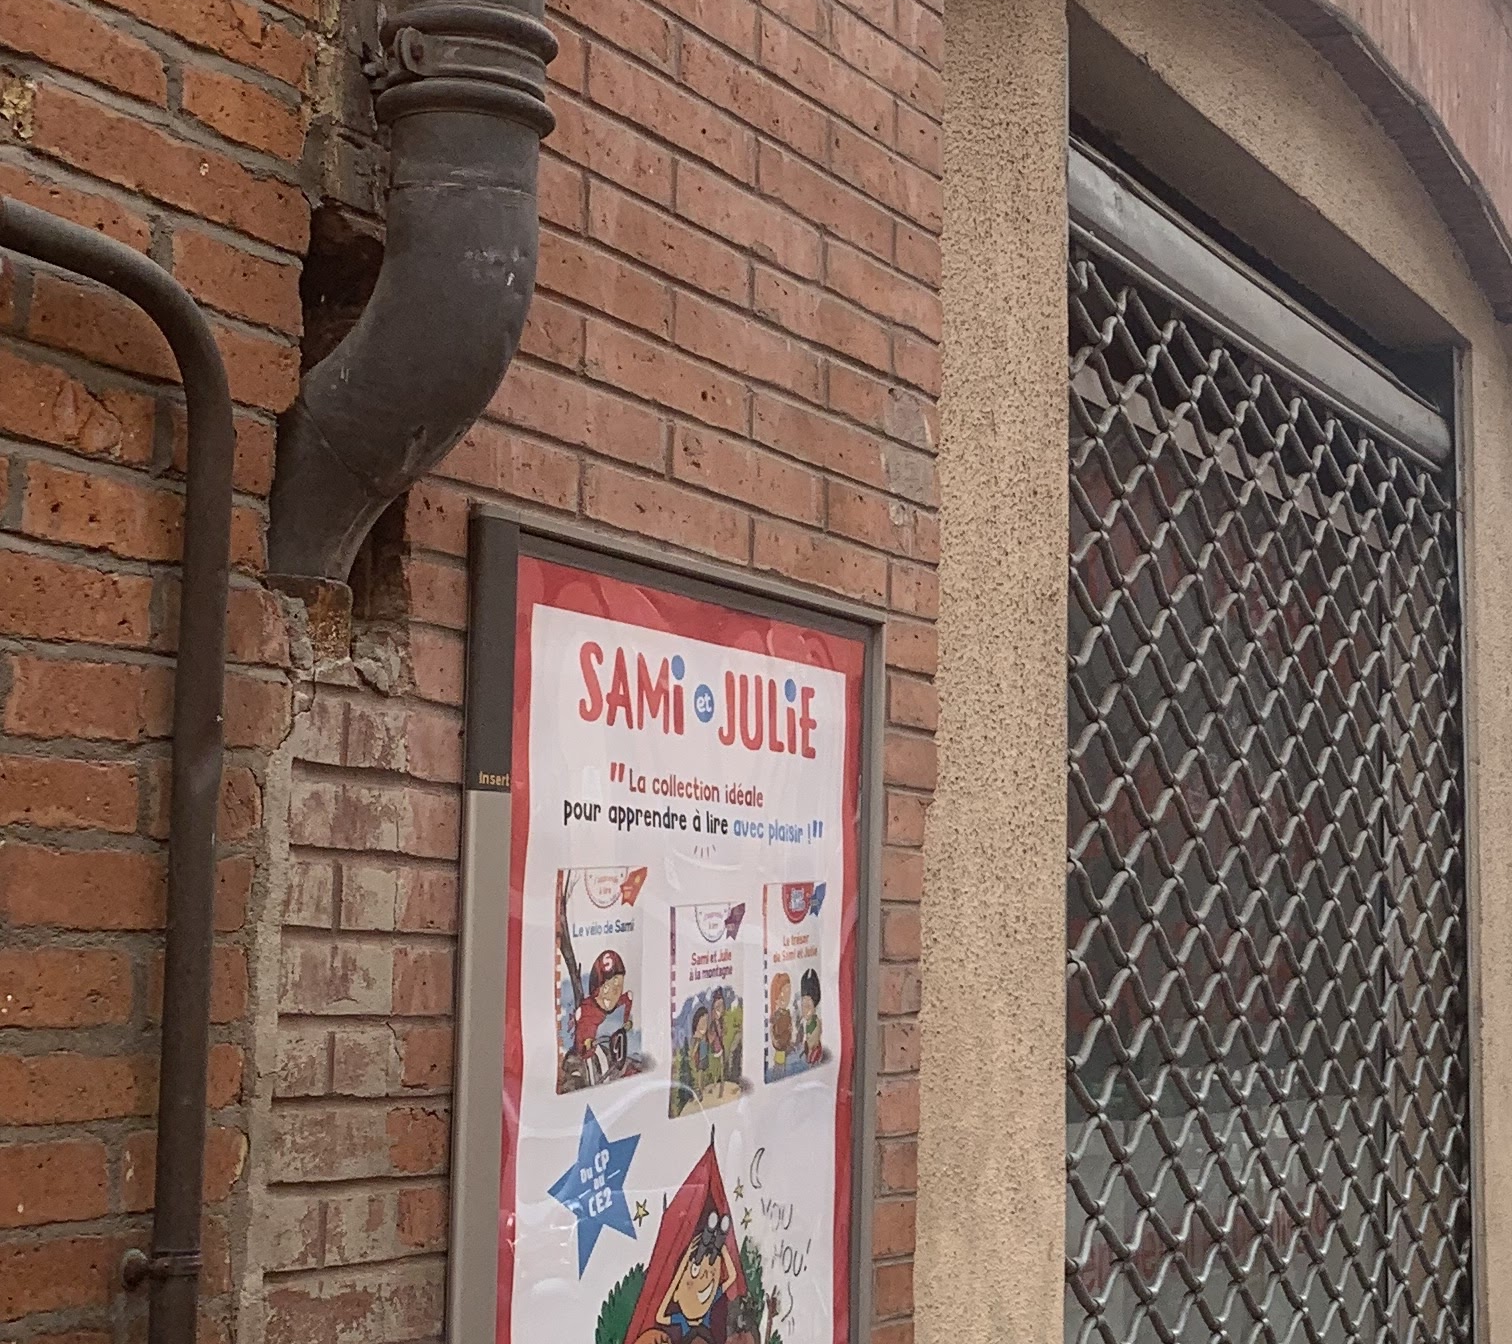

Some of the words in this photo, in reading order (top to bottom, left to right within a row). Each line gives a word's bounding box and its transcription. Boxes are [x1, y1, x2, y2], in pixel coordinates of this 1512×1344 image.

[696, 694, 713, 714] et
[479, 771, 510, 787] Insert
[652, 773, 721, 804] collection
[725, 782, 764, 808] idéale
[563, 799, 601, 826] pour
[608, 805, 687, 832] apprendre
[692, 809, 702, 833] à
[706, 811, 729, 835] lire
[733, 819, 764, 840] avec
[768, 819, 804, 845] plaisir
[572, 923, 584, 938] Le
[603, 921, 614, 934] de
[690, 950, 710, 966] Sami
[710, 950, 718, 964] et
[594, 1148, 610, 1173] CP
[588, 1187, 613, 1217] CE2
